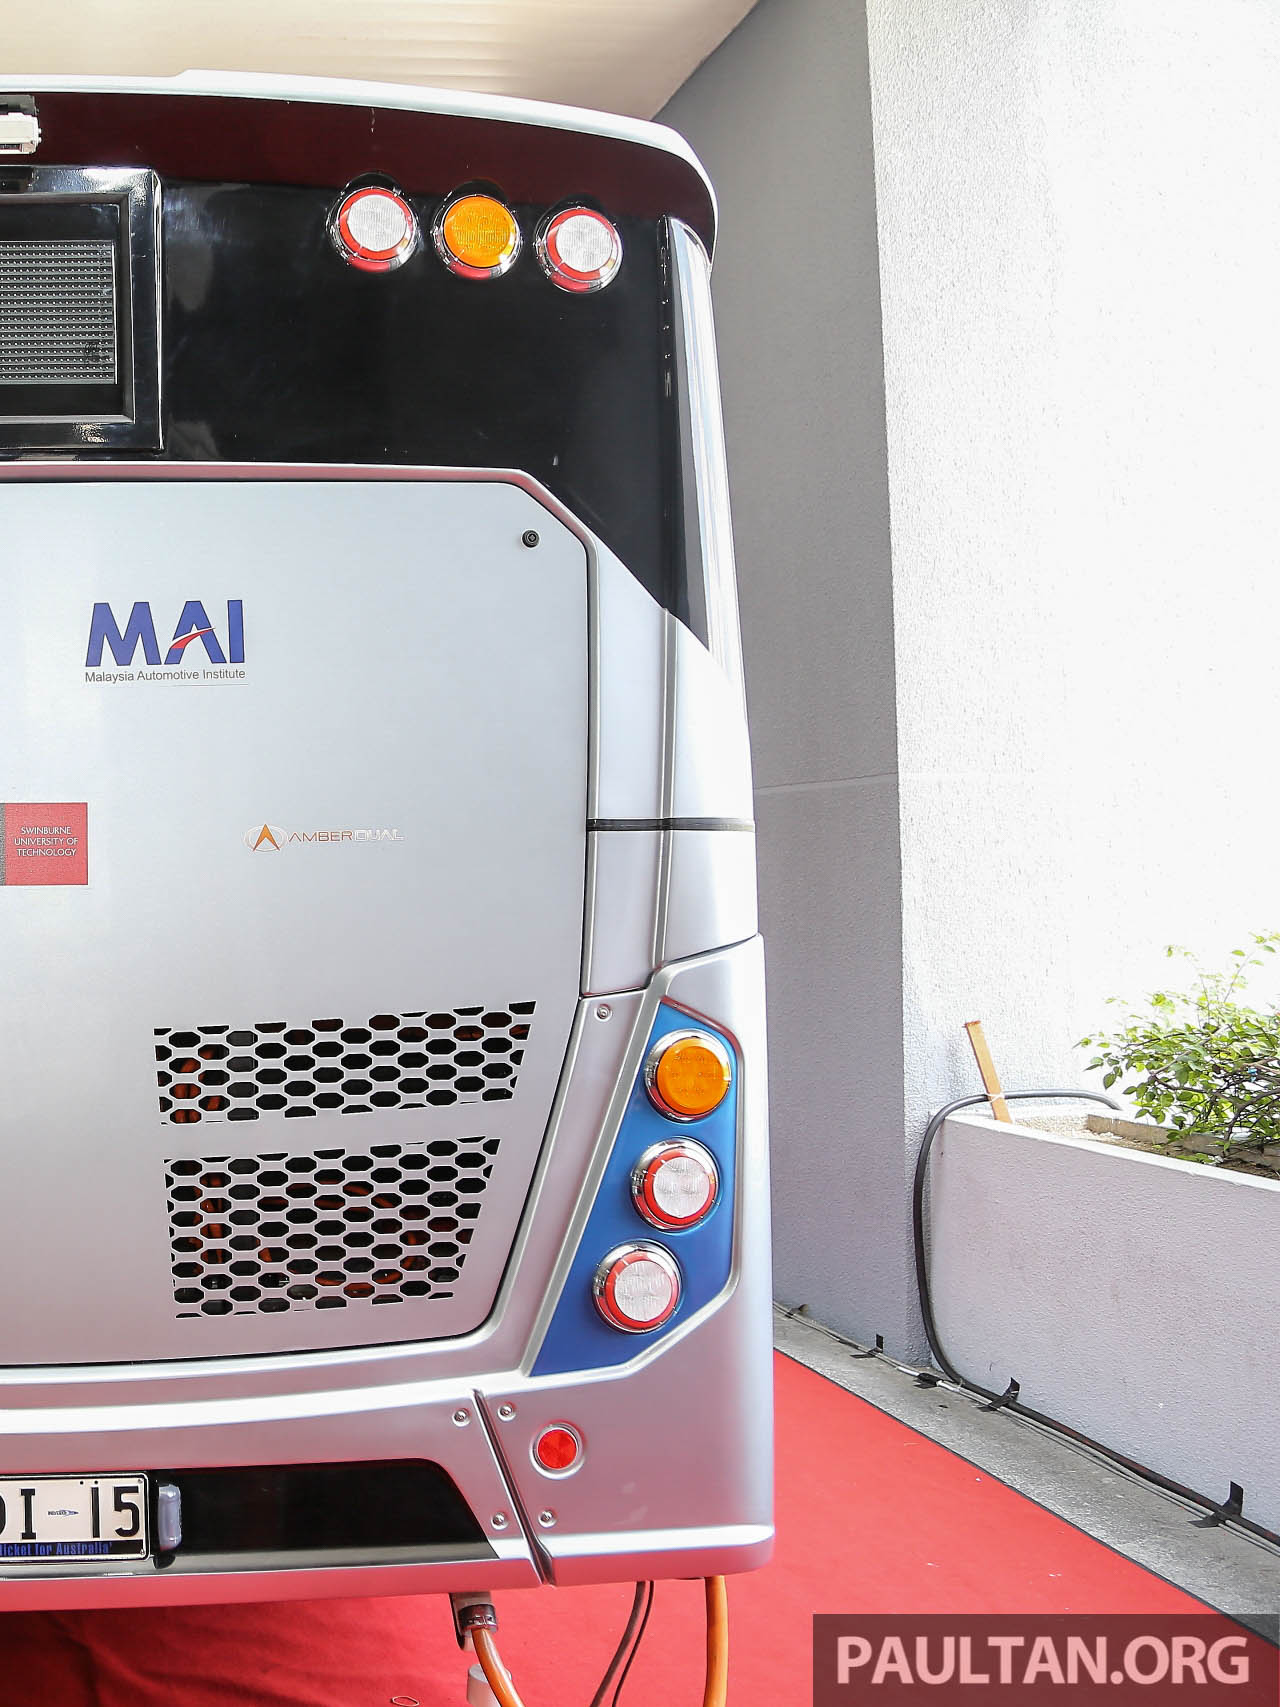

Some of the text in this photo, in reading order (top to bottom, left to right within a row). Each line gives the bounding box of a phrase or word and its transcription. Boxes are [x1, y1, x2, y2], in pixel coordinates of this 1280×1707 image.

[85, 599, 245, 667] MAI
[85, 668, 246, 684] Malaysia Automotive Institute
[21, 826, 72, 835] SWINBURNE
[14, 837, 79, 846] UNIVERSITY OF
[17, 848, 77, 857] TECHNOLOGY
